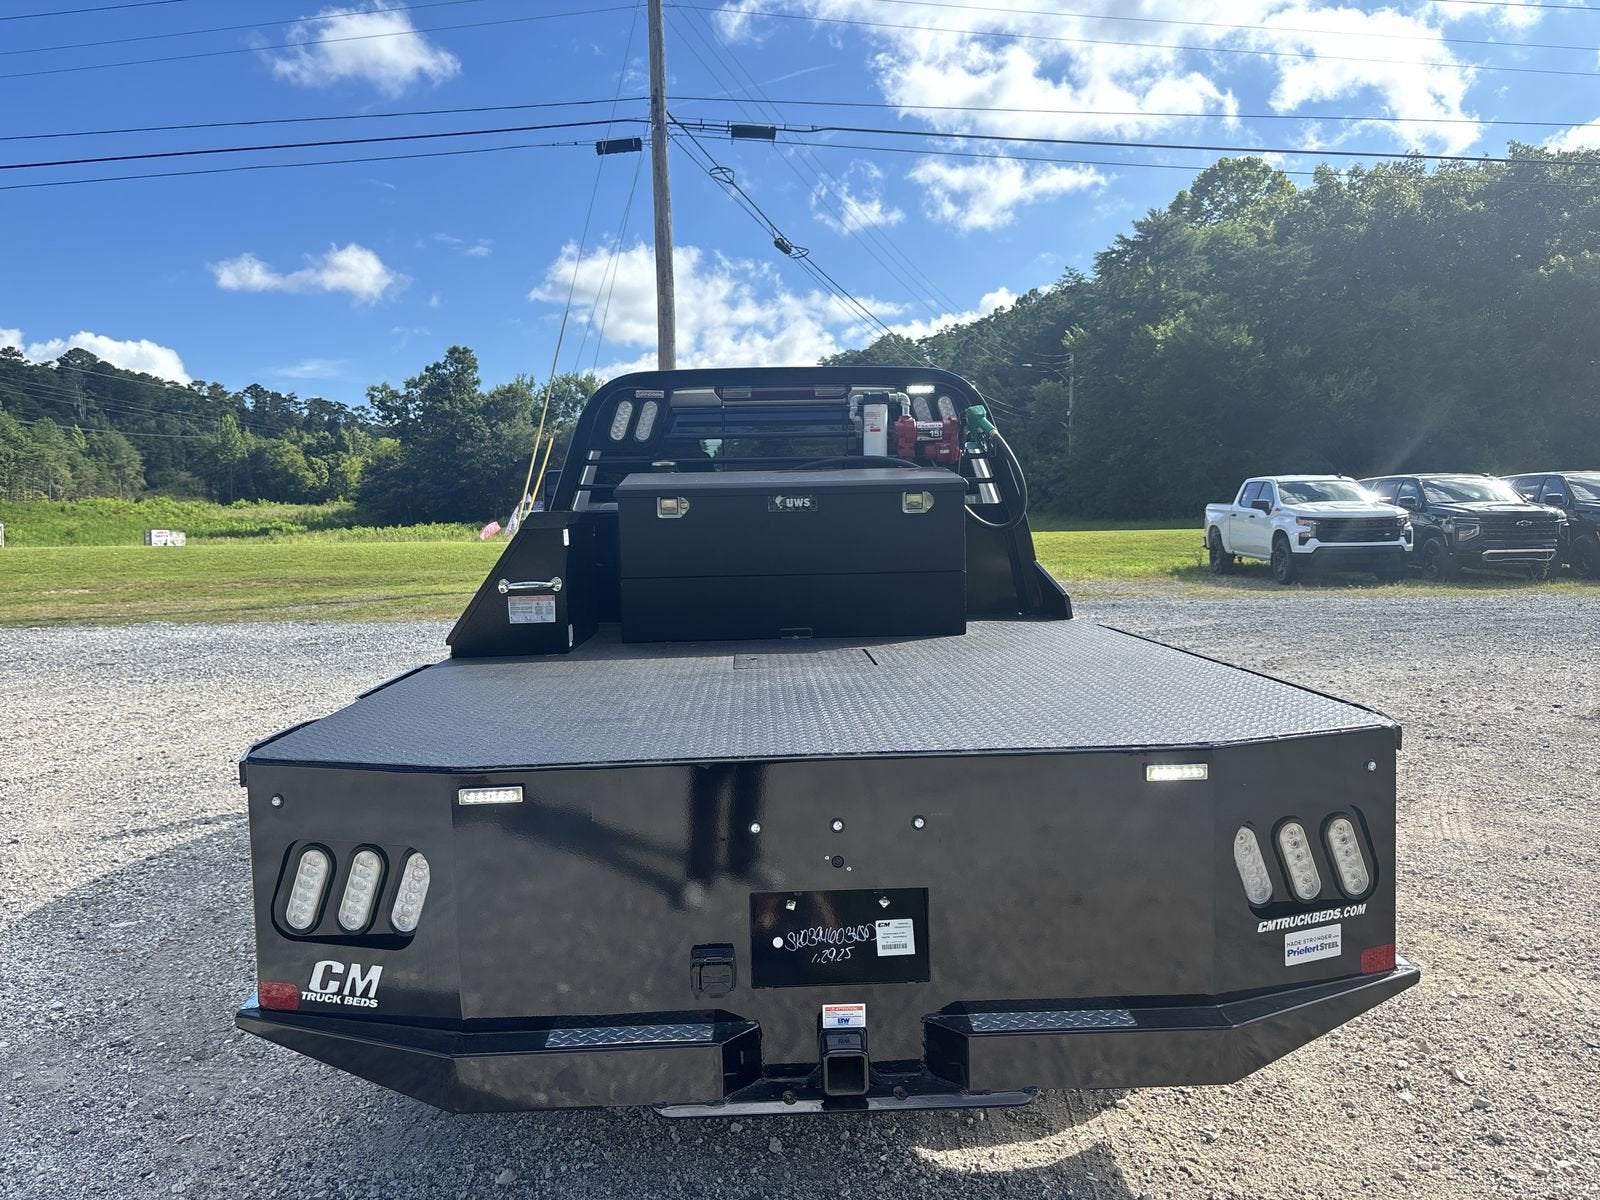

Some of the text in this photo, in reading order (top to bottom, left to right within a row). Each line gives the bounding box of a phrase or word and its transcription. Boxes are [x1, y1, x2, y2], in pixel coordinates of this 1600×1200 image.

[785, 498, 811, 507] UWS
[1257, 903, 1367, 933] CMTRUCKBEDS.COM
[1303, 933, 1332, 944] STRONGER
[308, 960, 384, 998] CM
[301, 991, 379, 1008] TRUCK BEDS
